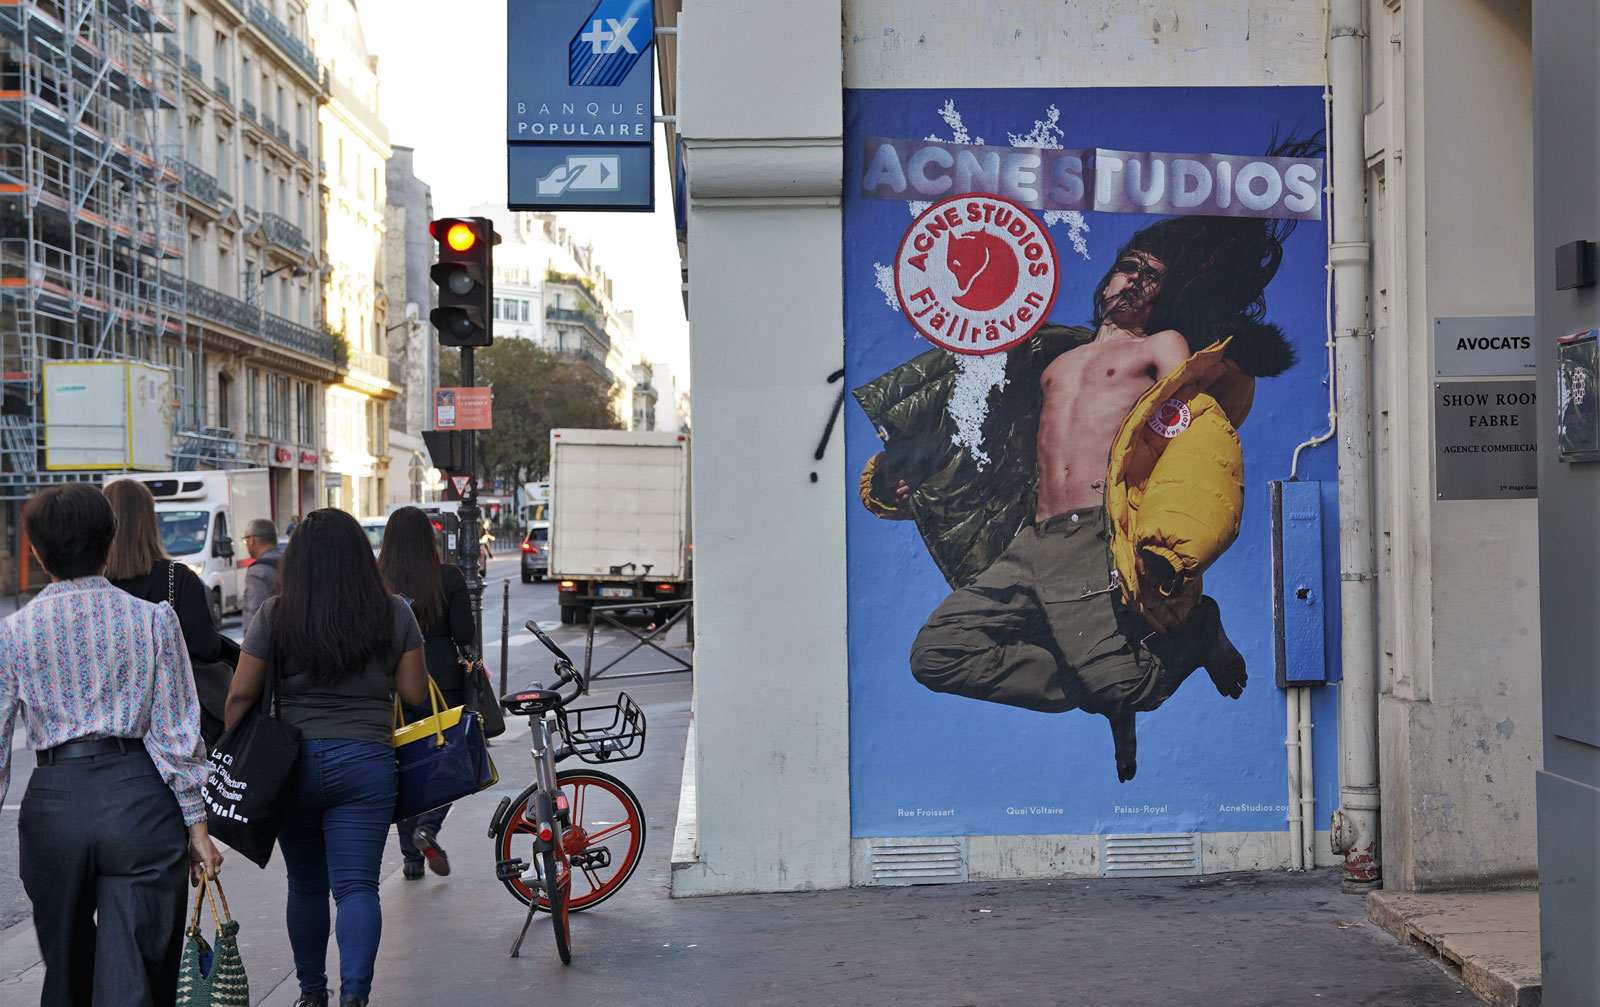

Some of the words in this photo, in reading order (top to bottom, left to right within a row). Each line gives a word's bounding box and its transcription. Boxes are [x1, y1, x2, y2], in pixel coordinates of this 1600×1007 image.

[517, 102, 644, 116] BANQUE
[517, 121, 644, 136] POPULAIRE
[863, 143, 1042, 202] ACNE
[1051, 155, 1317, 213] STUDIOS
[907, 206, 963, 272] ACNE
[966, 201, 1049, 277] STUDIOS
[909, 286, 1044, 343] Fjällräven
[1456, 336, 1531, 351] AVOCATS
[1442, 393, 1489, 407] SHOW
[1468, 414, 1519, 427] FABRE
[1443, 445, 1480, 454] AGENCE
[211, 748, 222, 759] La
[208, 775, 218, 786] du
[897, 808, 915, 817] Rue
[917, 808, 955, 817] Froissart
[1006, 806, 1028, 816] Quai
[1030, 806, 1064, 815] Voltaire
[1114, 804, 1168, 815] Palais-Royal
